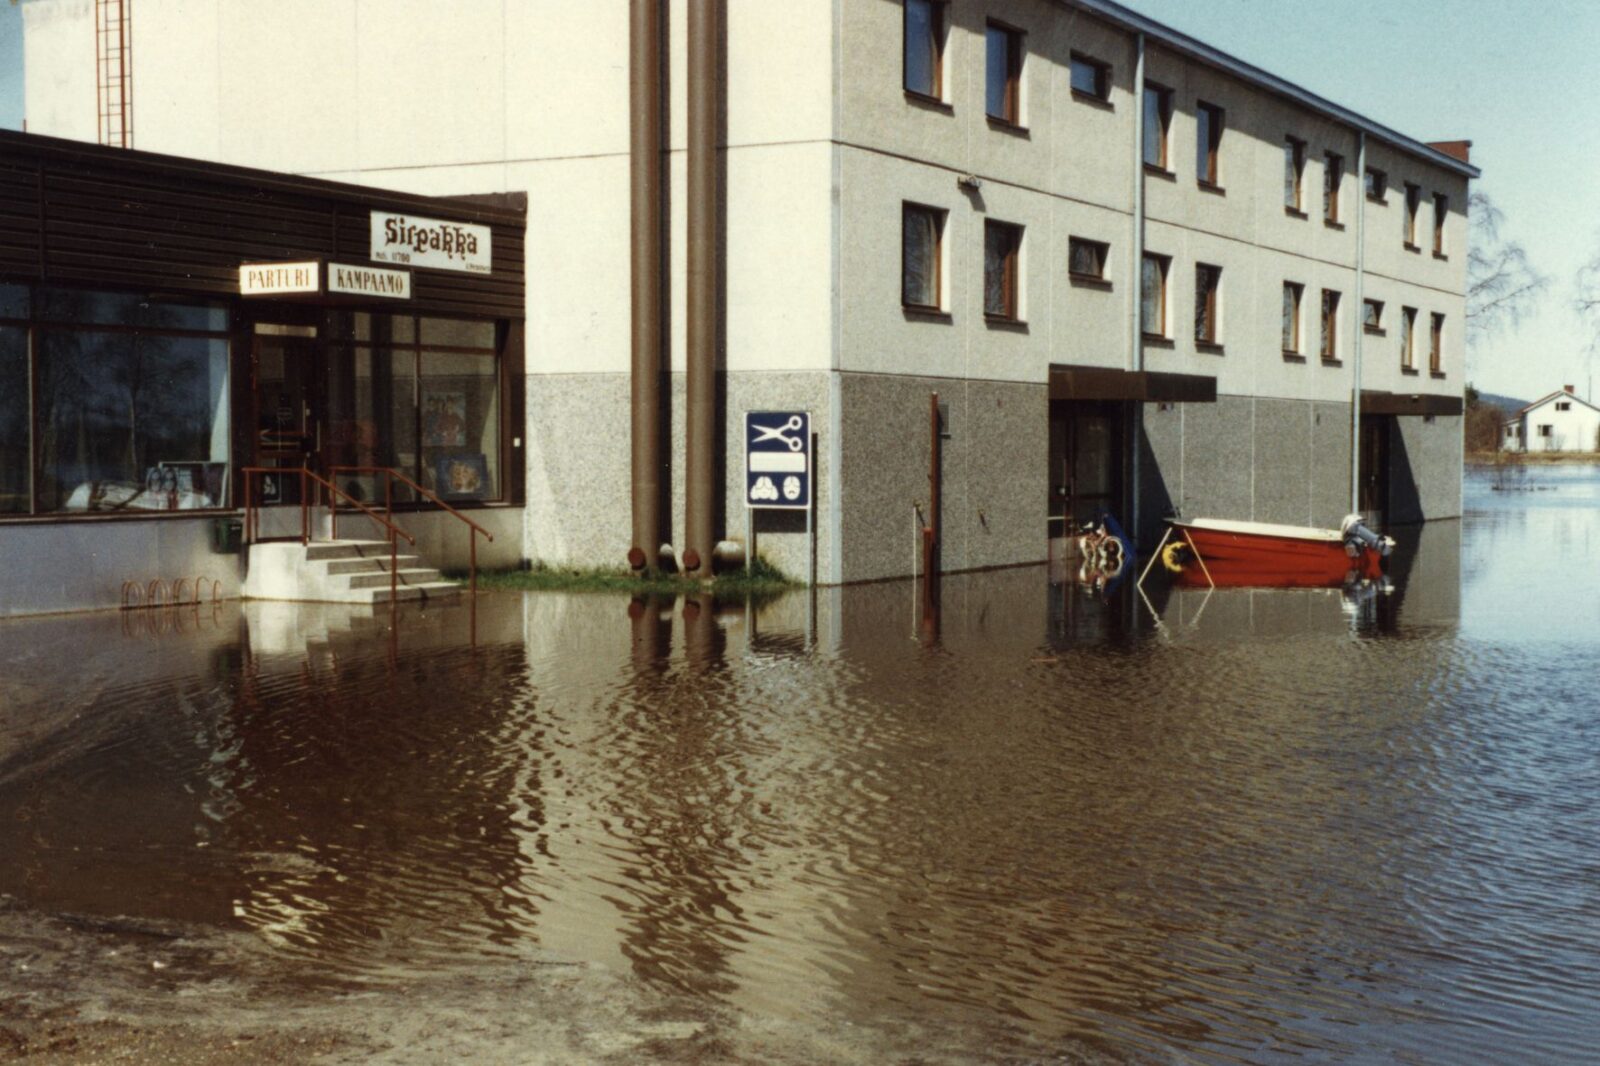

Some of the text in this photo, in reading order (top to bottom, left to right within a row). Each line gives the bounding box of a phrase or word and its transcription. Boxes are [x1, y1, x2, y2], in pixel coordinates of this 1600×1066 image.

[385, 217, 477, 260] Sirpakka
[249, 268, 309, 289] PARTURI
[337, 267, 403, 294] KAMPAAMO
